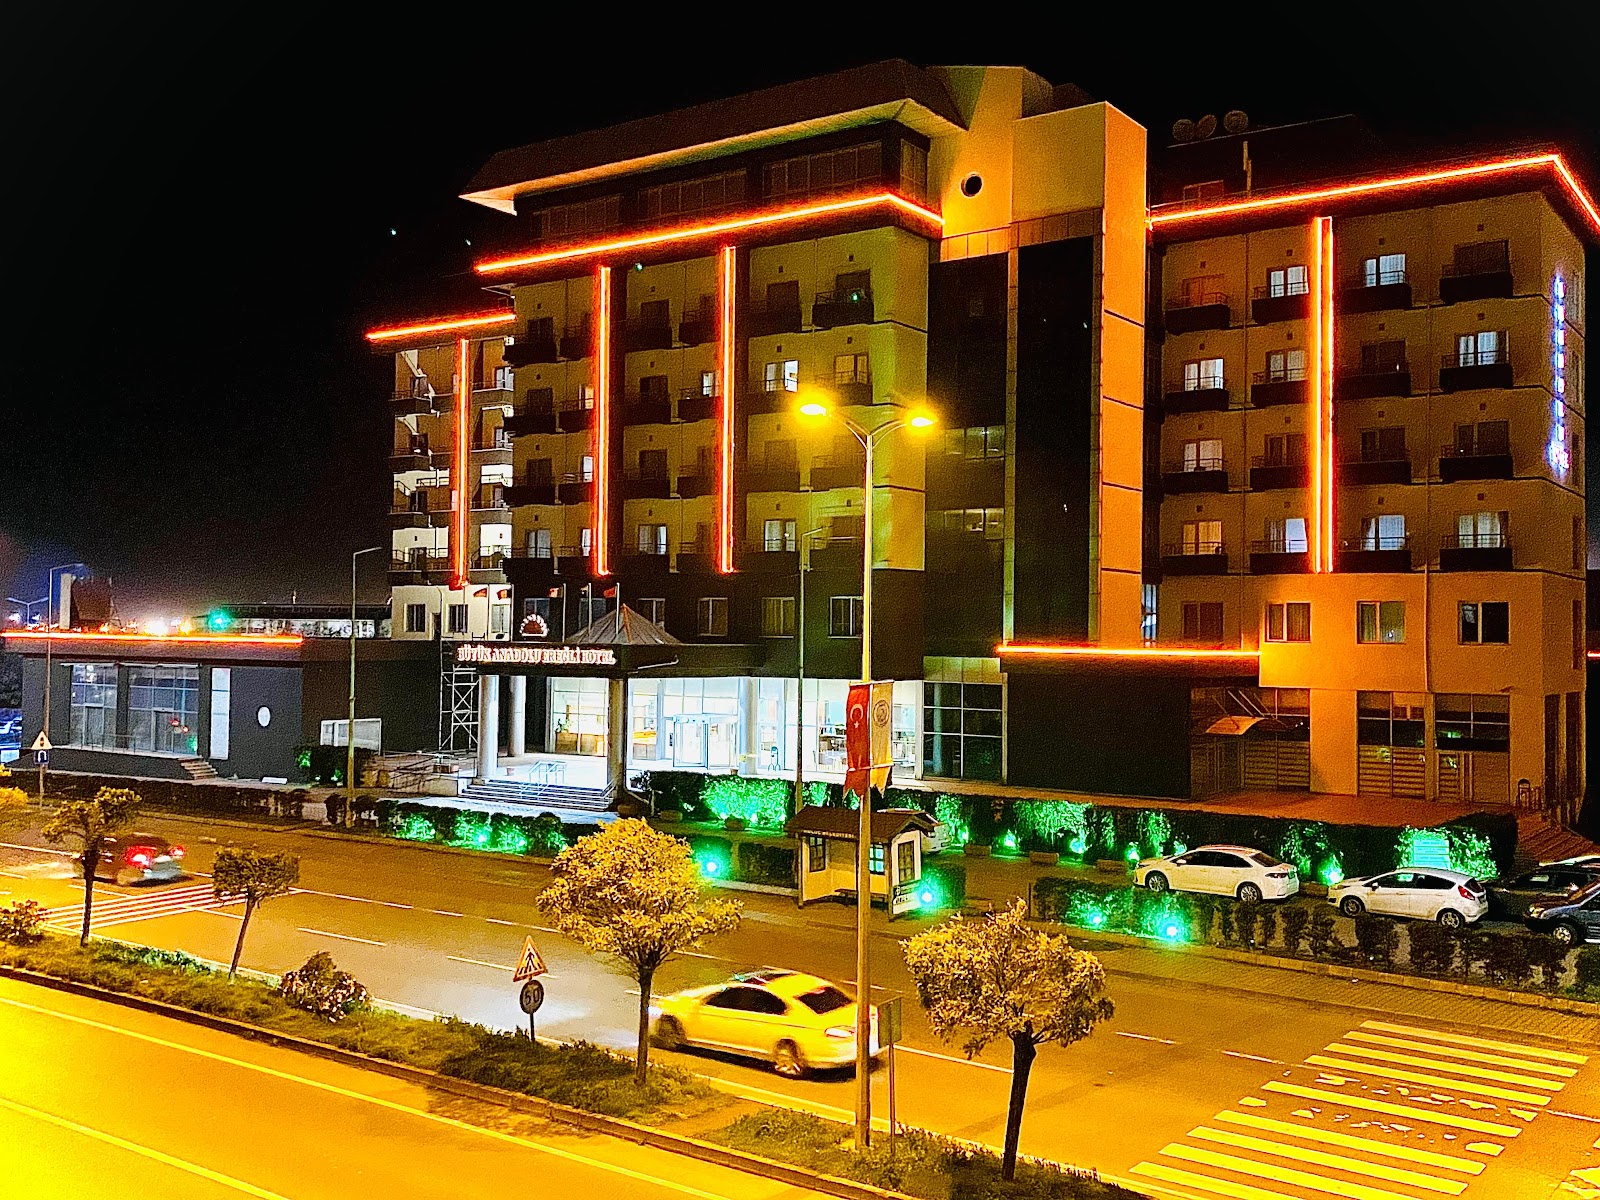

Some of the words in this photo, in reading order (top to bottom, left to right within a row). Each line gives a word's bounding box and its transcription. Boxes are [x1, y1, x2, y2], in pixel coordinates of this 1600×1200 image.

[457, 644, 491, 661] BÜYÜK
[491, 647, 541, 662] ANADOLU
[580, 649, 616, 665] HOTEL
